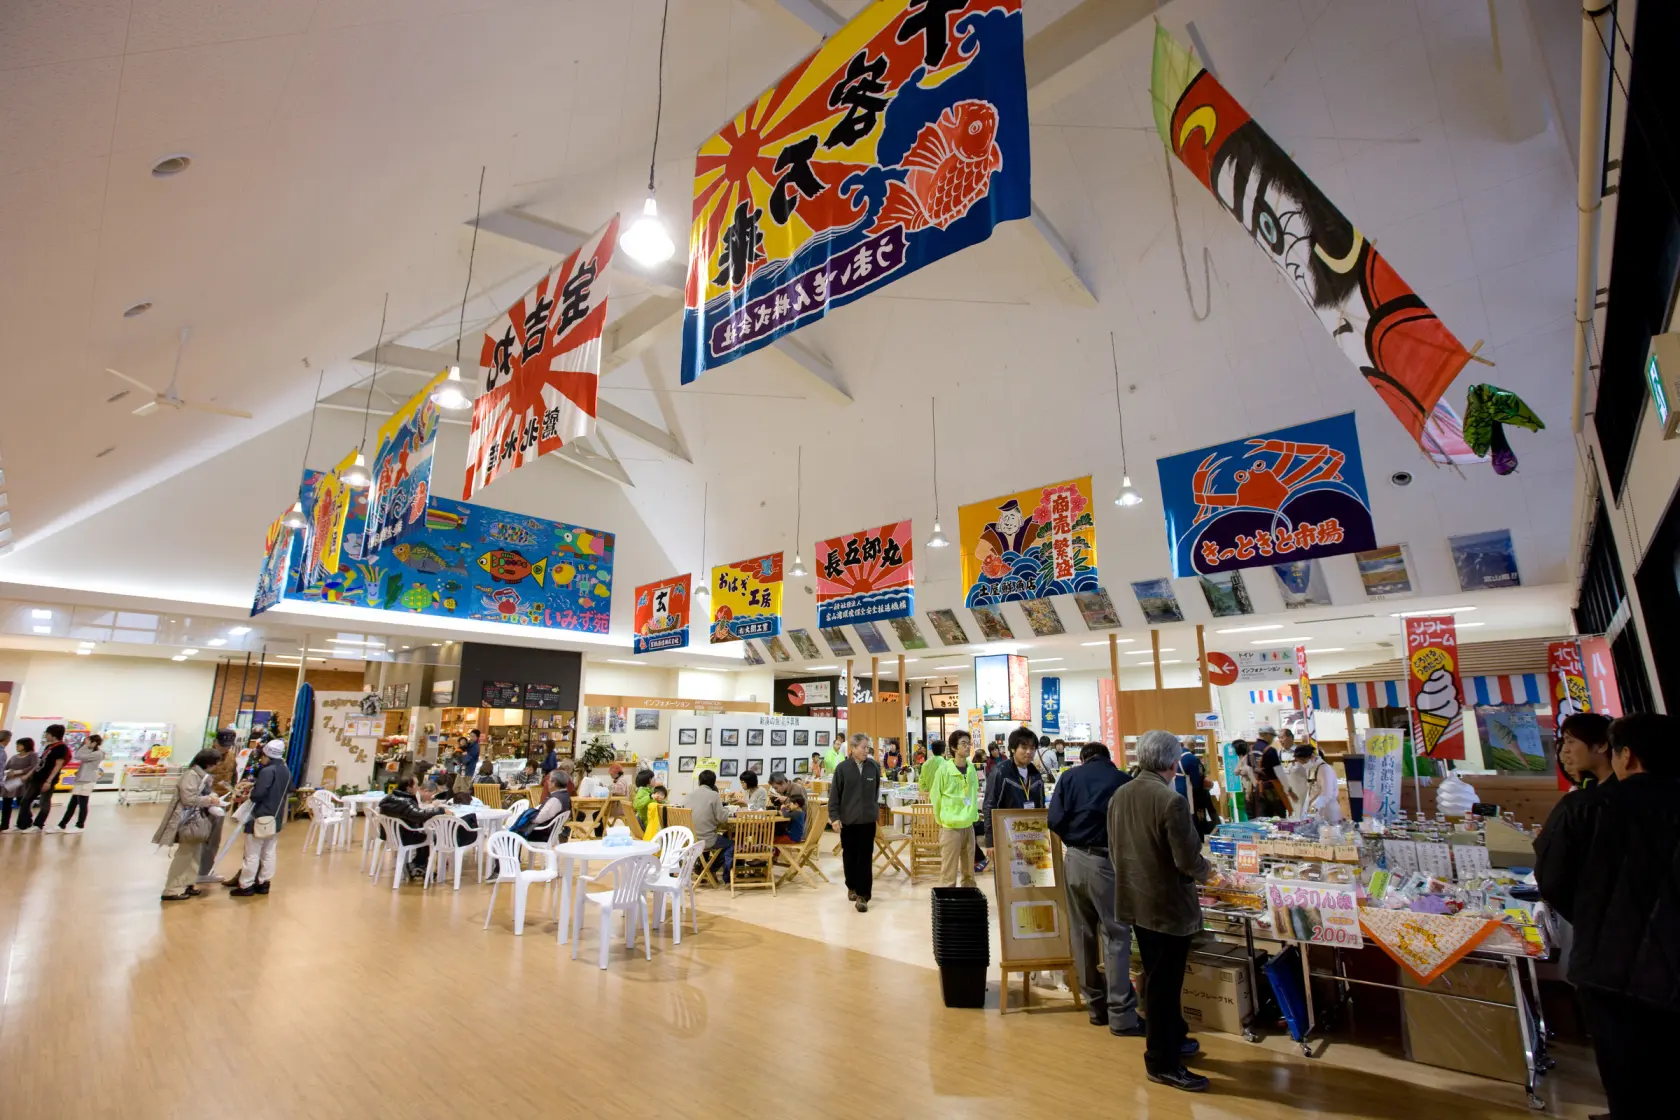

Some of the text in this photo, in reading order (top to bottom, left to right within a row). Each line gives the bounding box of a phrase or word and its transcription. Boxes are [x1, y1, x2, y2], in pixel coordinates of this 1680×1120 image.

[1052, 494, 1074, 579] 商売繁盛
[1201, 517, 1345, 566] きっときと市場
[824, 536, 903, 579] 長五郎丸
[655, 591, 668, 613] 玄
[748, 587, 772, 608] 工房
[544, 608, 610, 633] いみず苑
[1413, 620, 1454, 634] ソフト
[1409, 633, 1455, 647] クリーム
[643, 699, 691, 708] インフォメーション
[1311, 926, 1358, 945] 200円
